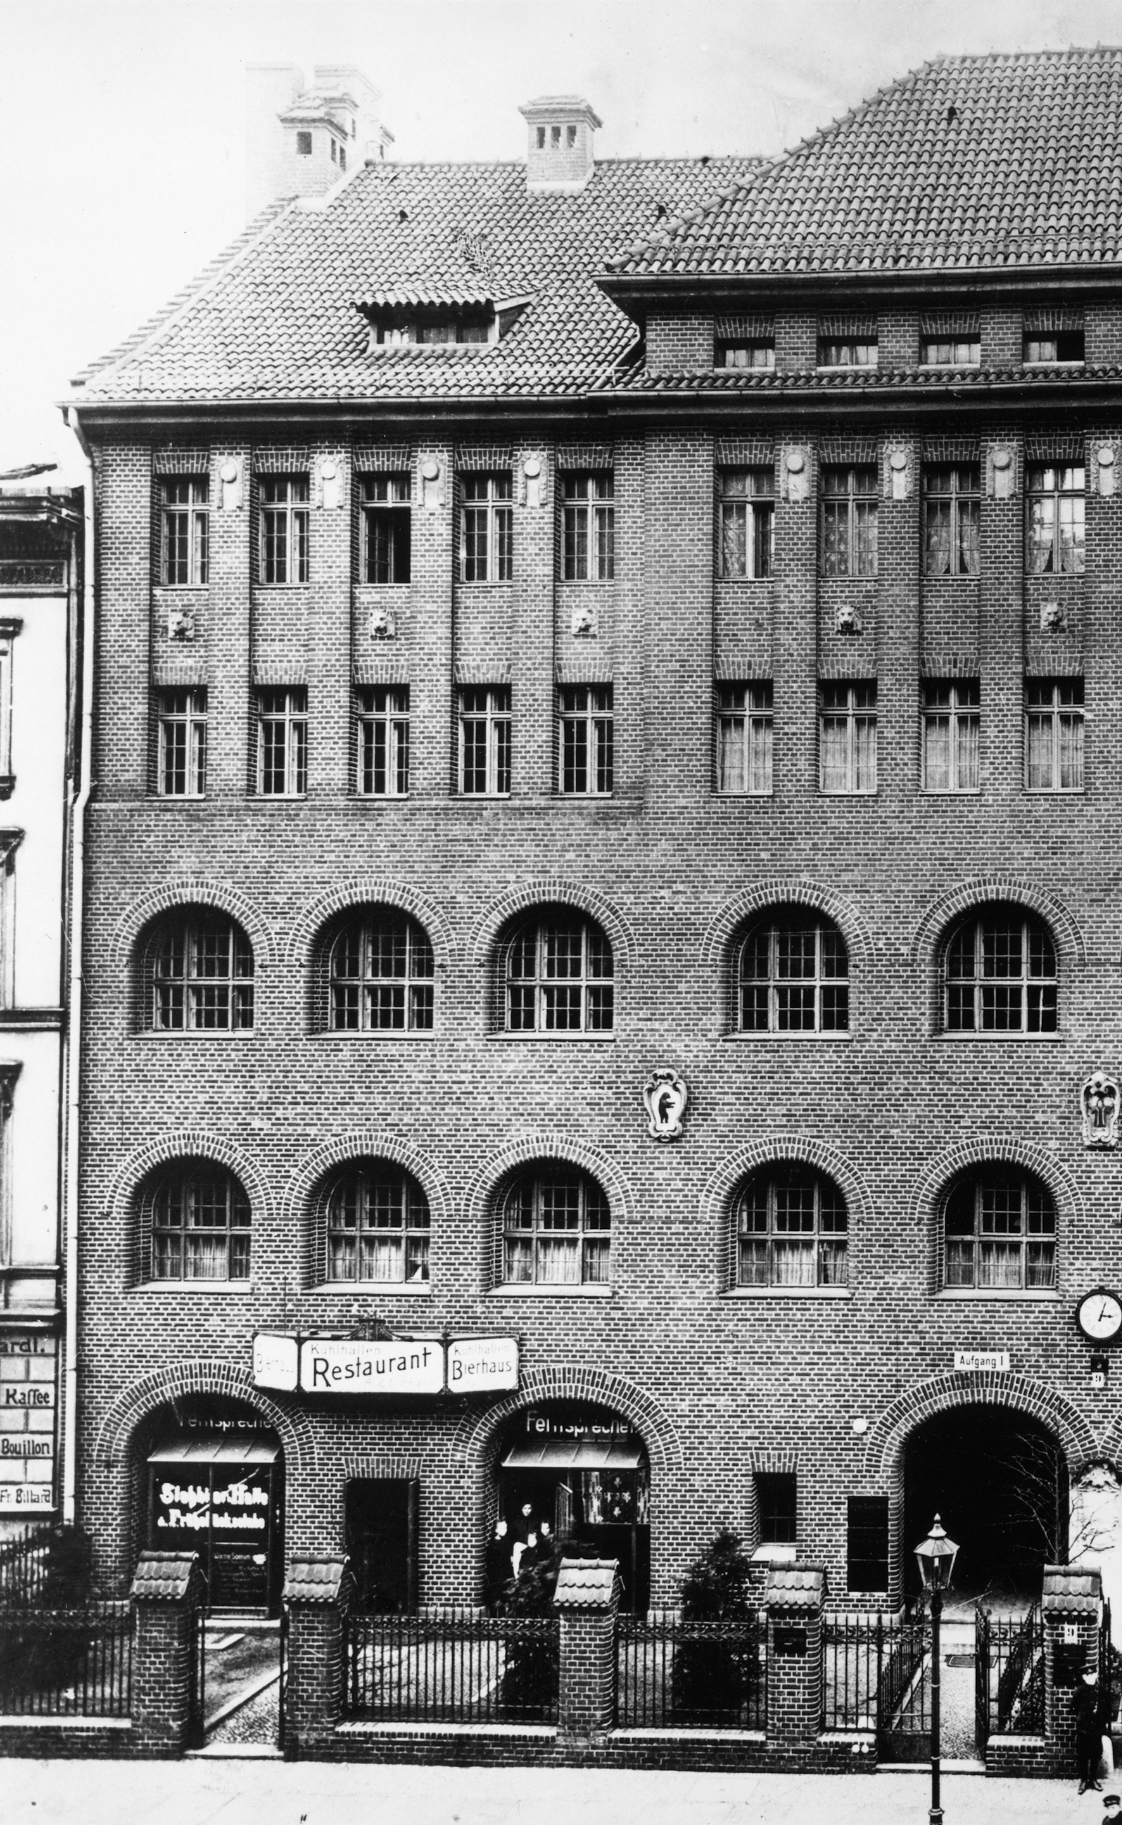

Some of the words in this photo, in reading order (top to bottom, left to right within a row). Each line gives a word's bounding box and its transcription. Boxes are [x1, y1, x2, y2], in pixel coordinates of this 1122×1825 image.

[313, 1347, 432, 1388] Restaurant
[452, 1355, 512, 1381] Bierhaus
[959, 1354, 996, 1369] Aufgang
[5, 1388, 50, 1405] Kaffee
[1, 1438, 50, 1456] Bouillon
[16, 1488, 51, 1504] Billard
